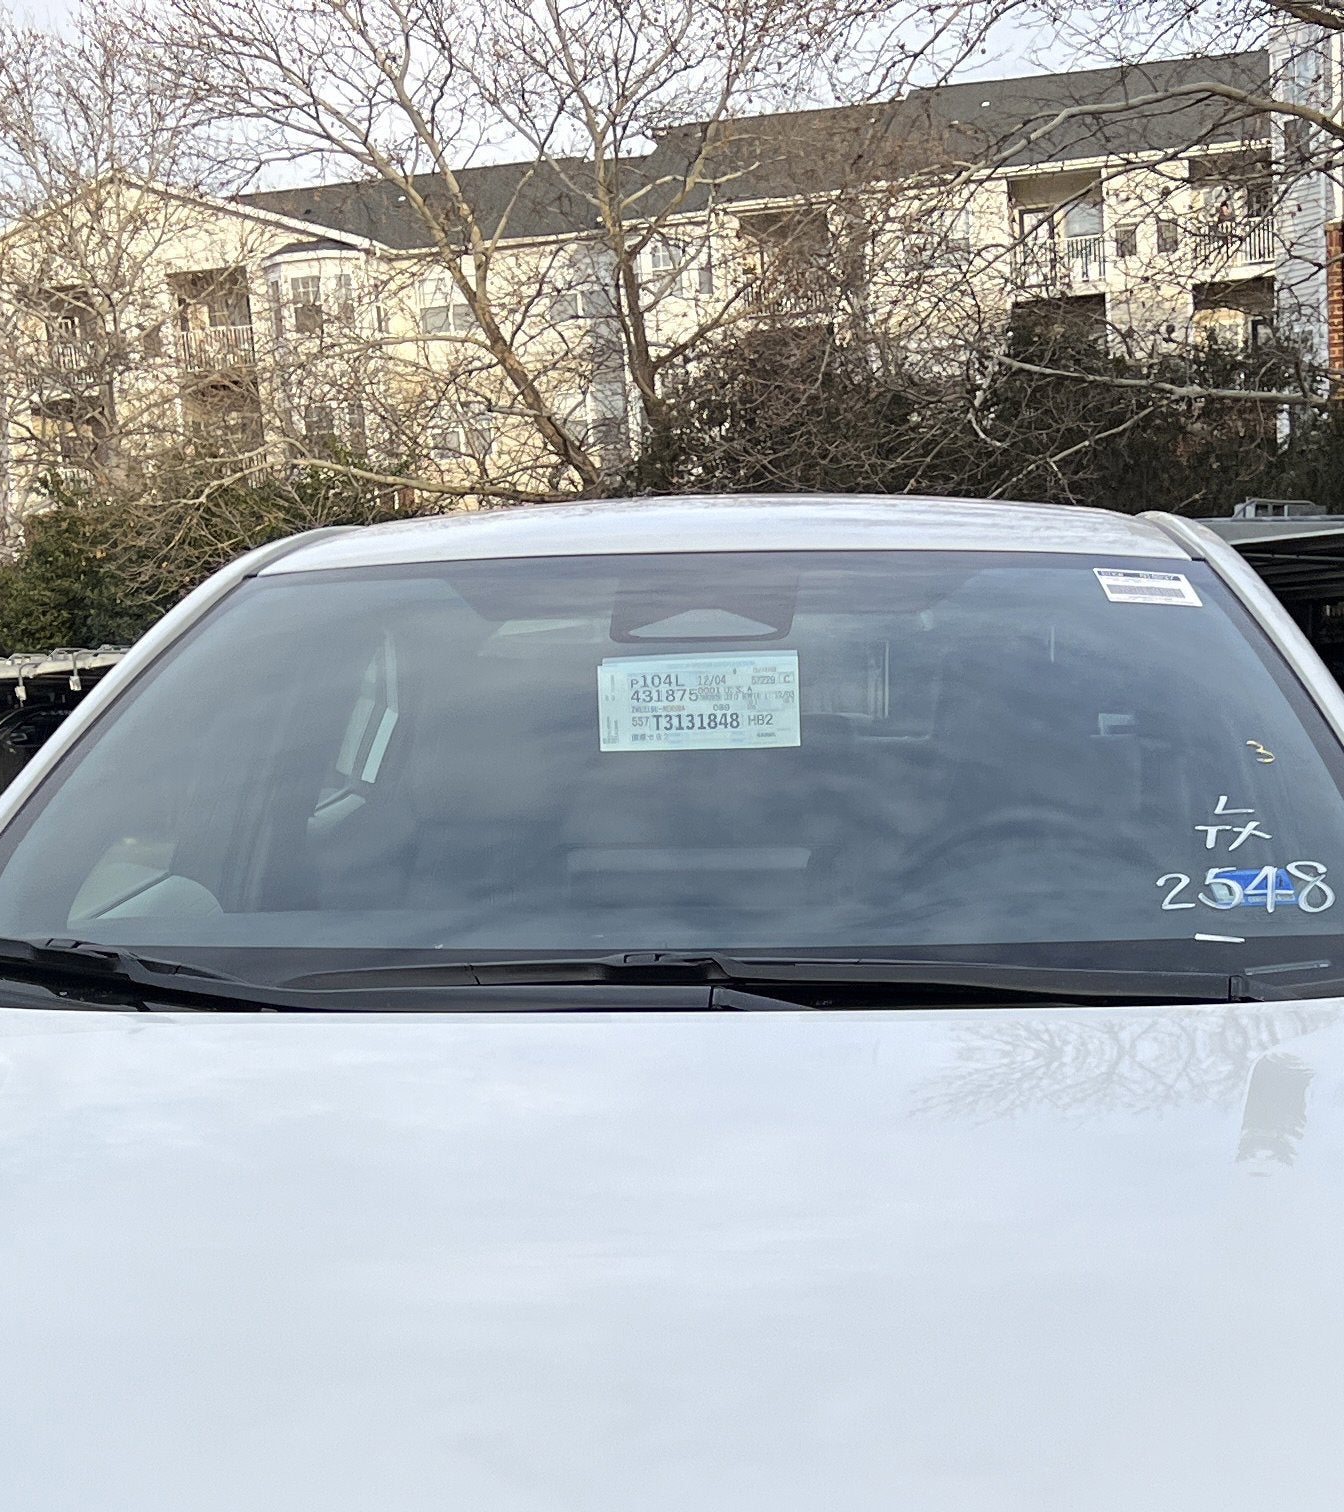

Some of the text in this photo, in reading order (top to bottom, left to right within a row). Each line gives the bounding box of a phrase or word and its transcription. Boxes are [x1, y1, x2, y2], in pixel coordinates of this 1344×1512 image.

[630, 687, 699, 704] 431875
[631, 712, 774, 731] 557 T3131848 HB2
[1156, 861, 1335, 913] 2548
